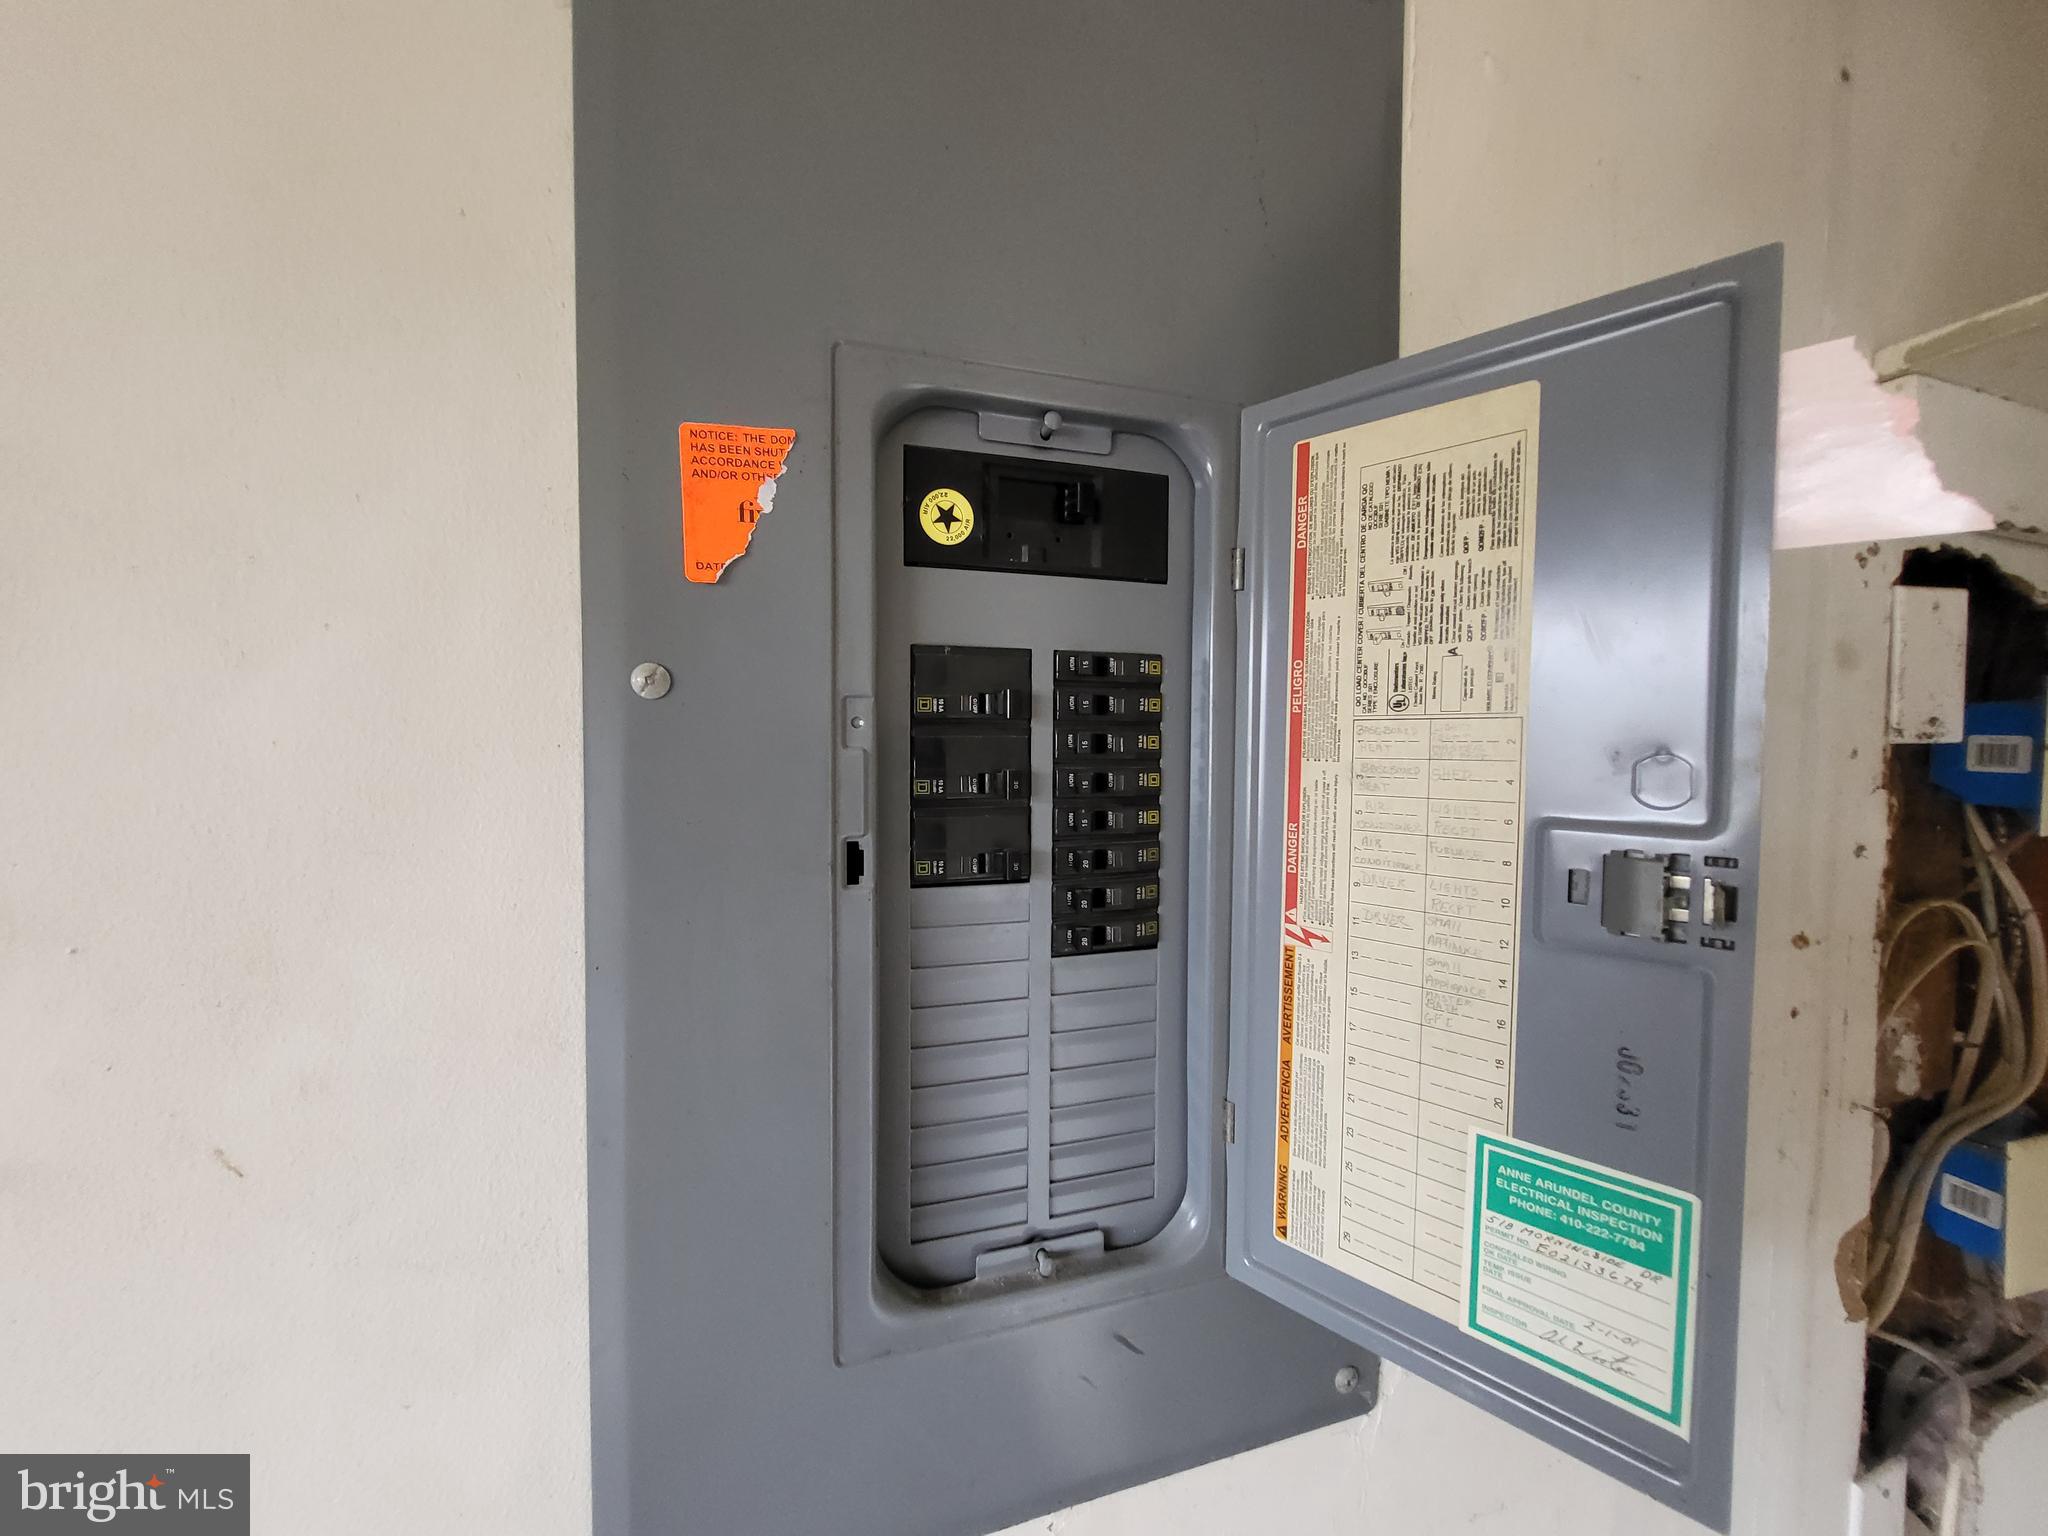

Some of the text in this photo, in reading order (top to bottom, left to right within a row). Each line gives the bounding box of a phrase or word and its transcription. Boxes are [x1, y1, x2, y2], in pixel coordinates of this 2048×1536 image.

[689, 429, 738, 442] NOTICE:
[743, 432, 766, 444] THE
[690, 443, 786, 458] HAS BEEN SHUT
[690, 456, 776, 470] ACCORDANCE
[691, 468, 739, 480] AND/OR
[922, 491, 949, 515] 22,000 AIR
[1296, 496, 1308, 549] DANGER
[946, 530, 966, 542] 22,000
[1448, 647, 1458, 655] A
[1082, 660, 1088, 668] 15
[1292, 660, 1303, 714] PELIGRO
[1082, 700, 1089, 708] 15
[1356, 696, 1361, 706] QO
[1082, 781, 1088, 789] 15
[1082, 819, 1088, 827] 15
[1287, 822, 1298, 874] DANGER
[1083, 860, 1089, 868] 20
[1359, 871, 1407, 888] DRYER
[1081, 900, 1088, 908] 20
[1501, 898, 1510, 908] 10
[1352, 916, 1360, 925] 11
[1362, 908, 1410, 927] DRYER
[1082, 938, 1088, 946] 20
[1500, 939, 1510, 950] 12
[1352, 951, 1359, 960] 13
[1498, 979, 1508, 989] 14
[1282, 946, 1294, 1046] AVERTISSEMENT
[1350, 987, 1358, 996] 15
[1350, 1022, 1357, 1031] 17
[1497, 1019, 1506, 1030] 16
[1348, 1056, 1356, 1066] 19
[1495, 1059, 1505, 1070] 18
[1280, 1060, 1291, 1143] ADVERTENCIA
[1347, 1092, 1356, 1104] 21
[1493, 1098, 1504, 1110] 20
[1346, 1127, 1354, 1138] 23
[1345, 1161, 1353, 1172] 25
[1278, 1164, 1288, 1220] WARNING
[1496, 1164, 1662, 1227] ANNE ARUNDEL COUNTY
[1344, 1196, 1352, 1207] 27
[1495, 1177, 1664, 1244] ELECTRICAL INSPECTION
[1508, 1195, 1558, 1221] PHONE:
[1343, 1232, 1352, 1243] 29
[1484, 1226, 1514, 1240] PERMIT
[1484, 1240, 1567, 1278] CONCEALED WIRING
[1497, 1254, 1518, 1266] DATE
[1520, 1228, 1626, 1268] MORNINGSIDE
[1640, 1270, 1663, 1284] DR
[1483, 1266, 1503, 1280] DATE
[1482, 1285, 1575, 1330] FINAL APPROVAL DATE
[1482, 1303, 1528, 1328] INSPECTOR
